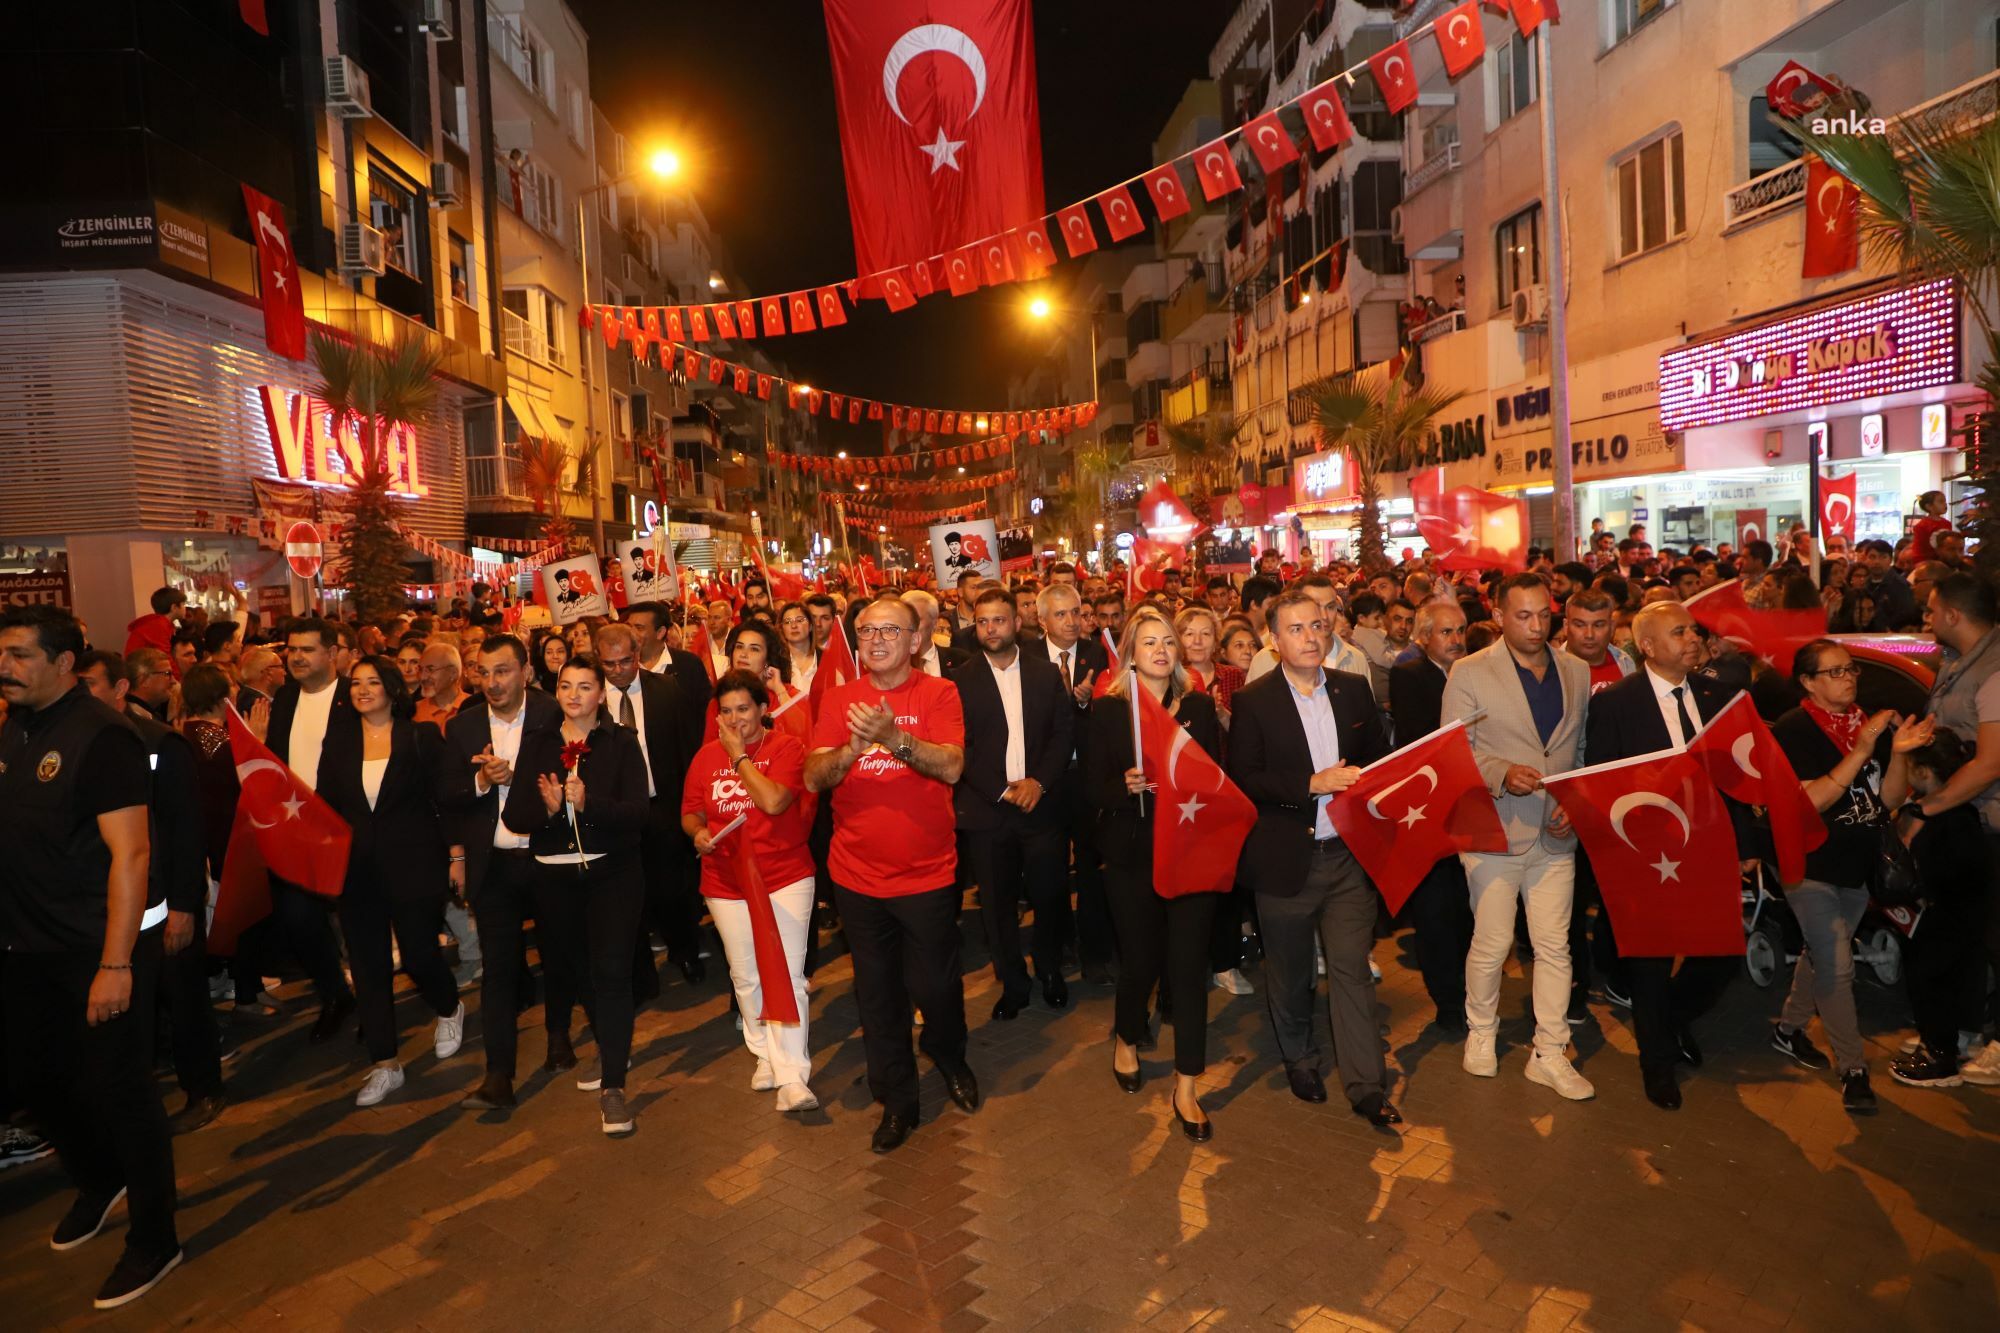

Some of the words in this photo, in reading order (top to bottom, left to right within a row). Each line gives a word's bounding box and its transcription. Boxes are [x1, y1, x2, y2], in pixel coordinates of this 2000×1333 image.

[78, 214, 153, 232] ZENGİNLER
[169, 222, 207, 250] ZENGİNLER
[1692, 364, 1712, 398] Bi
[1725, 350, 1792, 389] Dünya
[1807, 322, 1894, 374] Kapak
[1513, 386, 1551, 422] UĞU
[1617, 384, 1642, 399] EKVATOR
[258, 385, 430, 496] VESEL
[1525, 434, 1629, 473] PRFİLO
